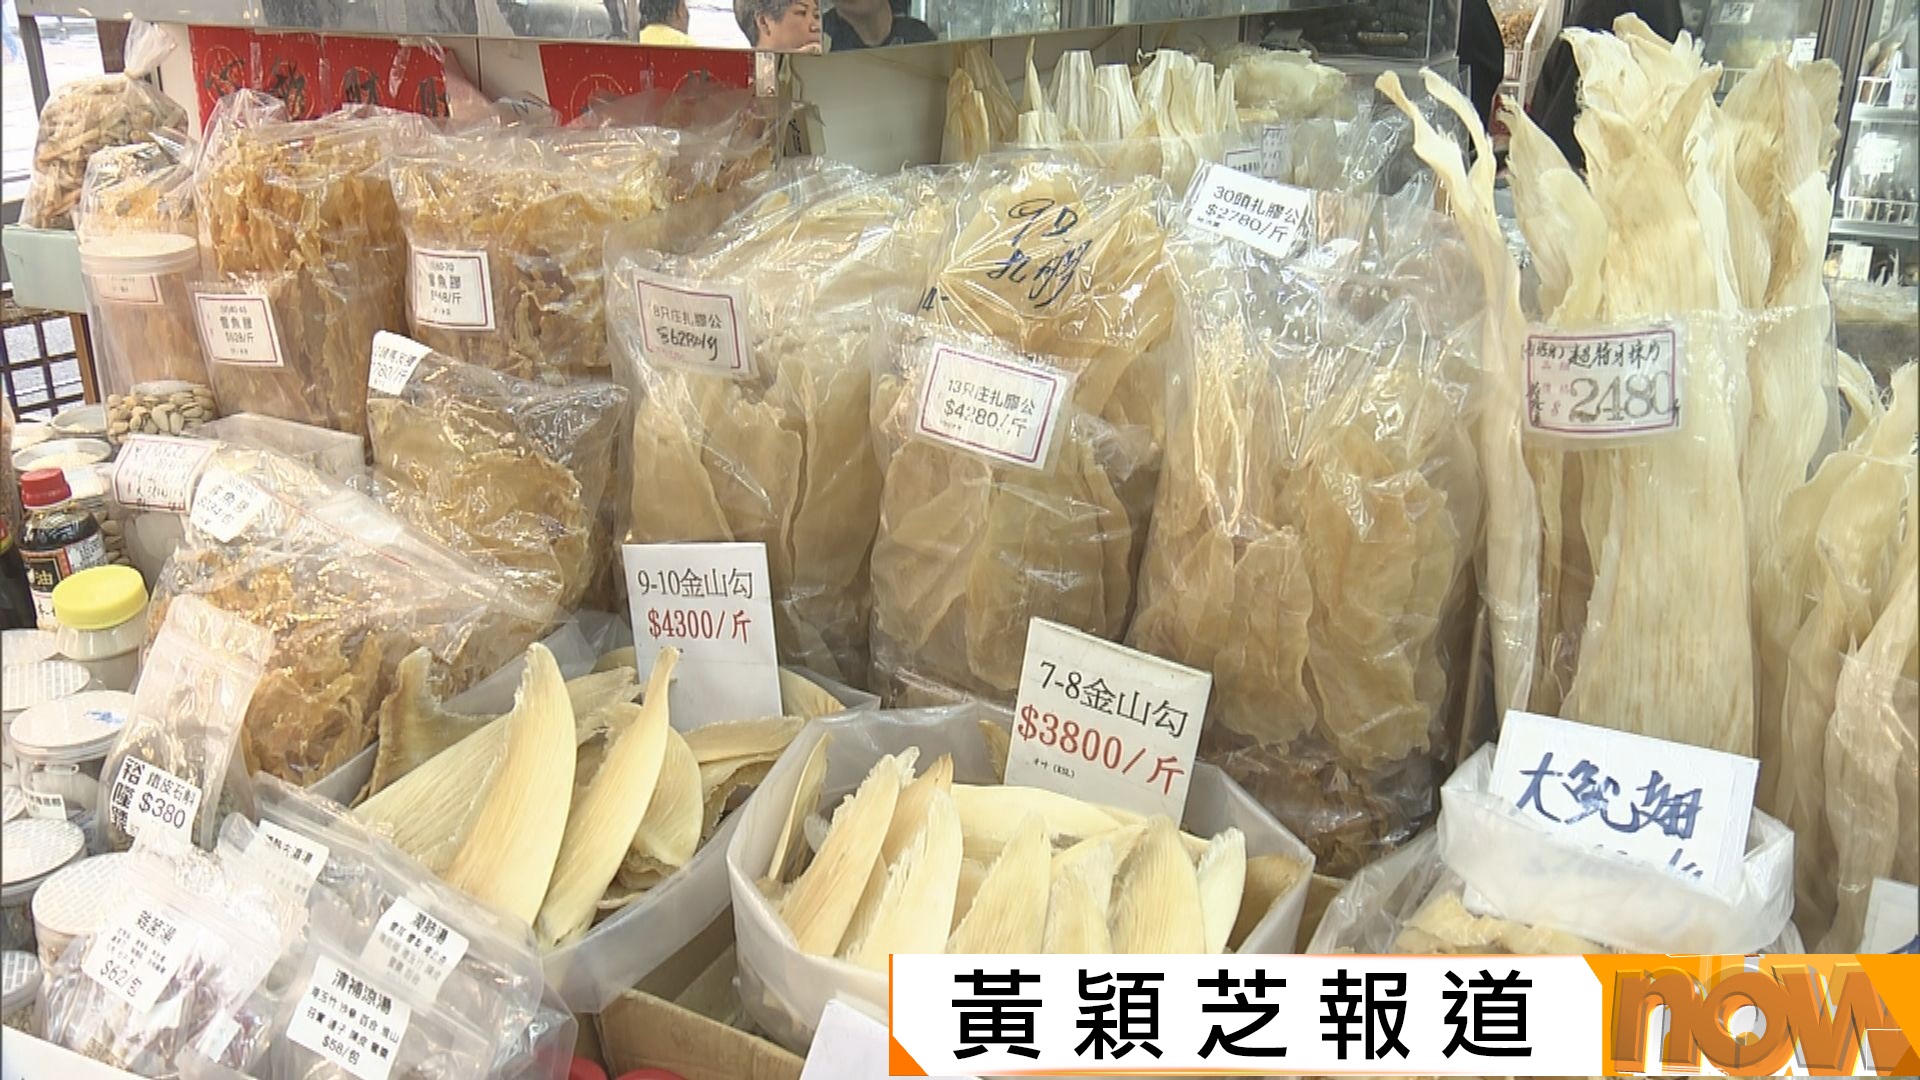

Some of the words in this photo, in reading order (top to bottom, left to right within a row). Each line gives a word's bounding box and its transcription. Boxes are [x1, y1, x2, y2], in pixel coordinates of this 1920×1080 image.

[1205, 203, 1288, 242] $2780/斤
[1569, 371, 1671, 423] 2480
[637, 567, 753, 600] 9-10金山勾
[648, 607, 752, 645] $4300/斤
[1040, 660, 1189, 739] 7-8金山勾
[1017, 703, 1185, 796] $3800/斤
[138, 791, 187, 829] $380
[331, 967, 393, 1016] 清補涼湯
[321, 1033, 361, 1067] $58/包
